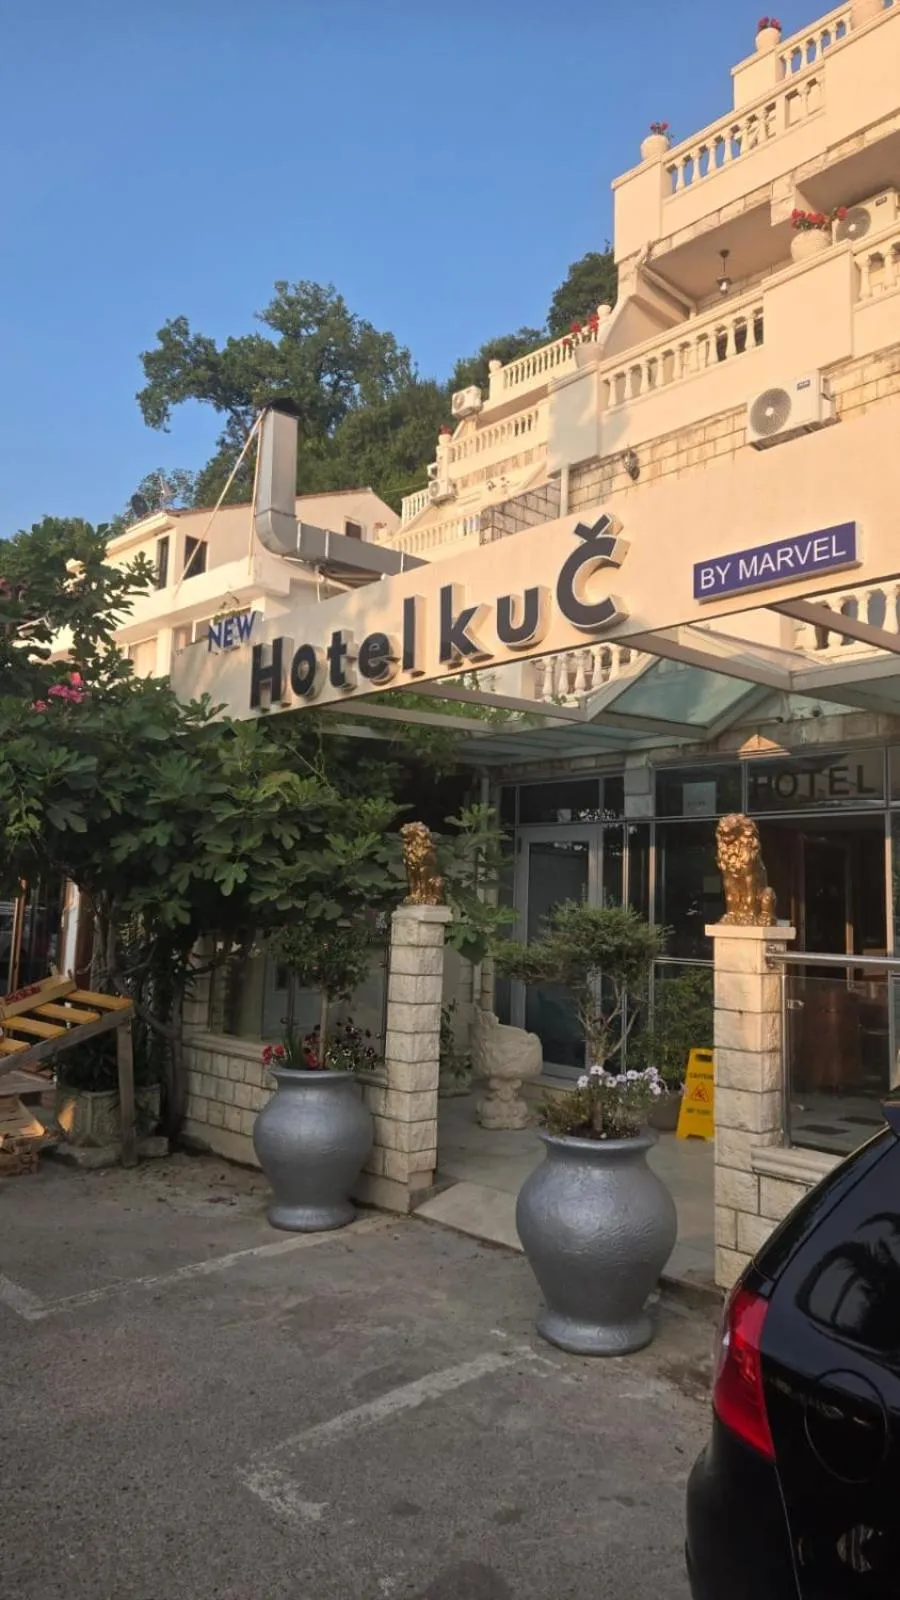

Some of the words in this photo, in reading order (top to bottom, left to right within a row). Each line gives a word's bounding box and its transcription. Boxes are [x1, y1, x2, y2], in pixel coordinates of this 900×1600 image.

[700, 562, 732, 590] BY
[739, 535, 847, 579] MARVEL
[207, 611, 257, 652] NEW
[250, 595, 424, 711] Hotel
